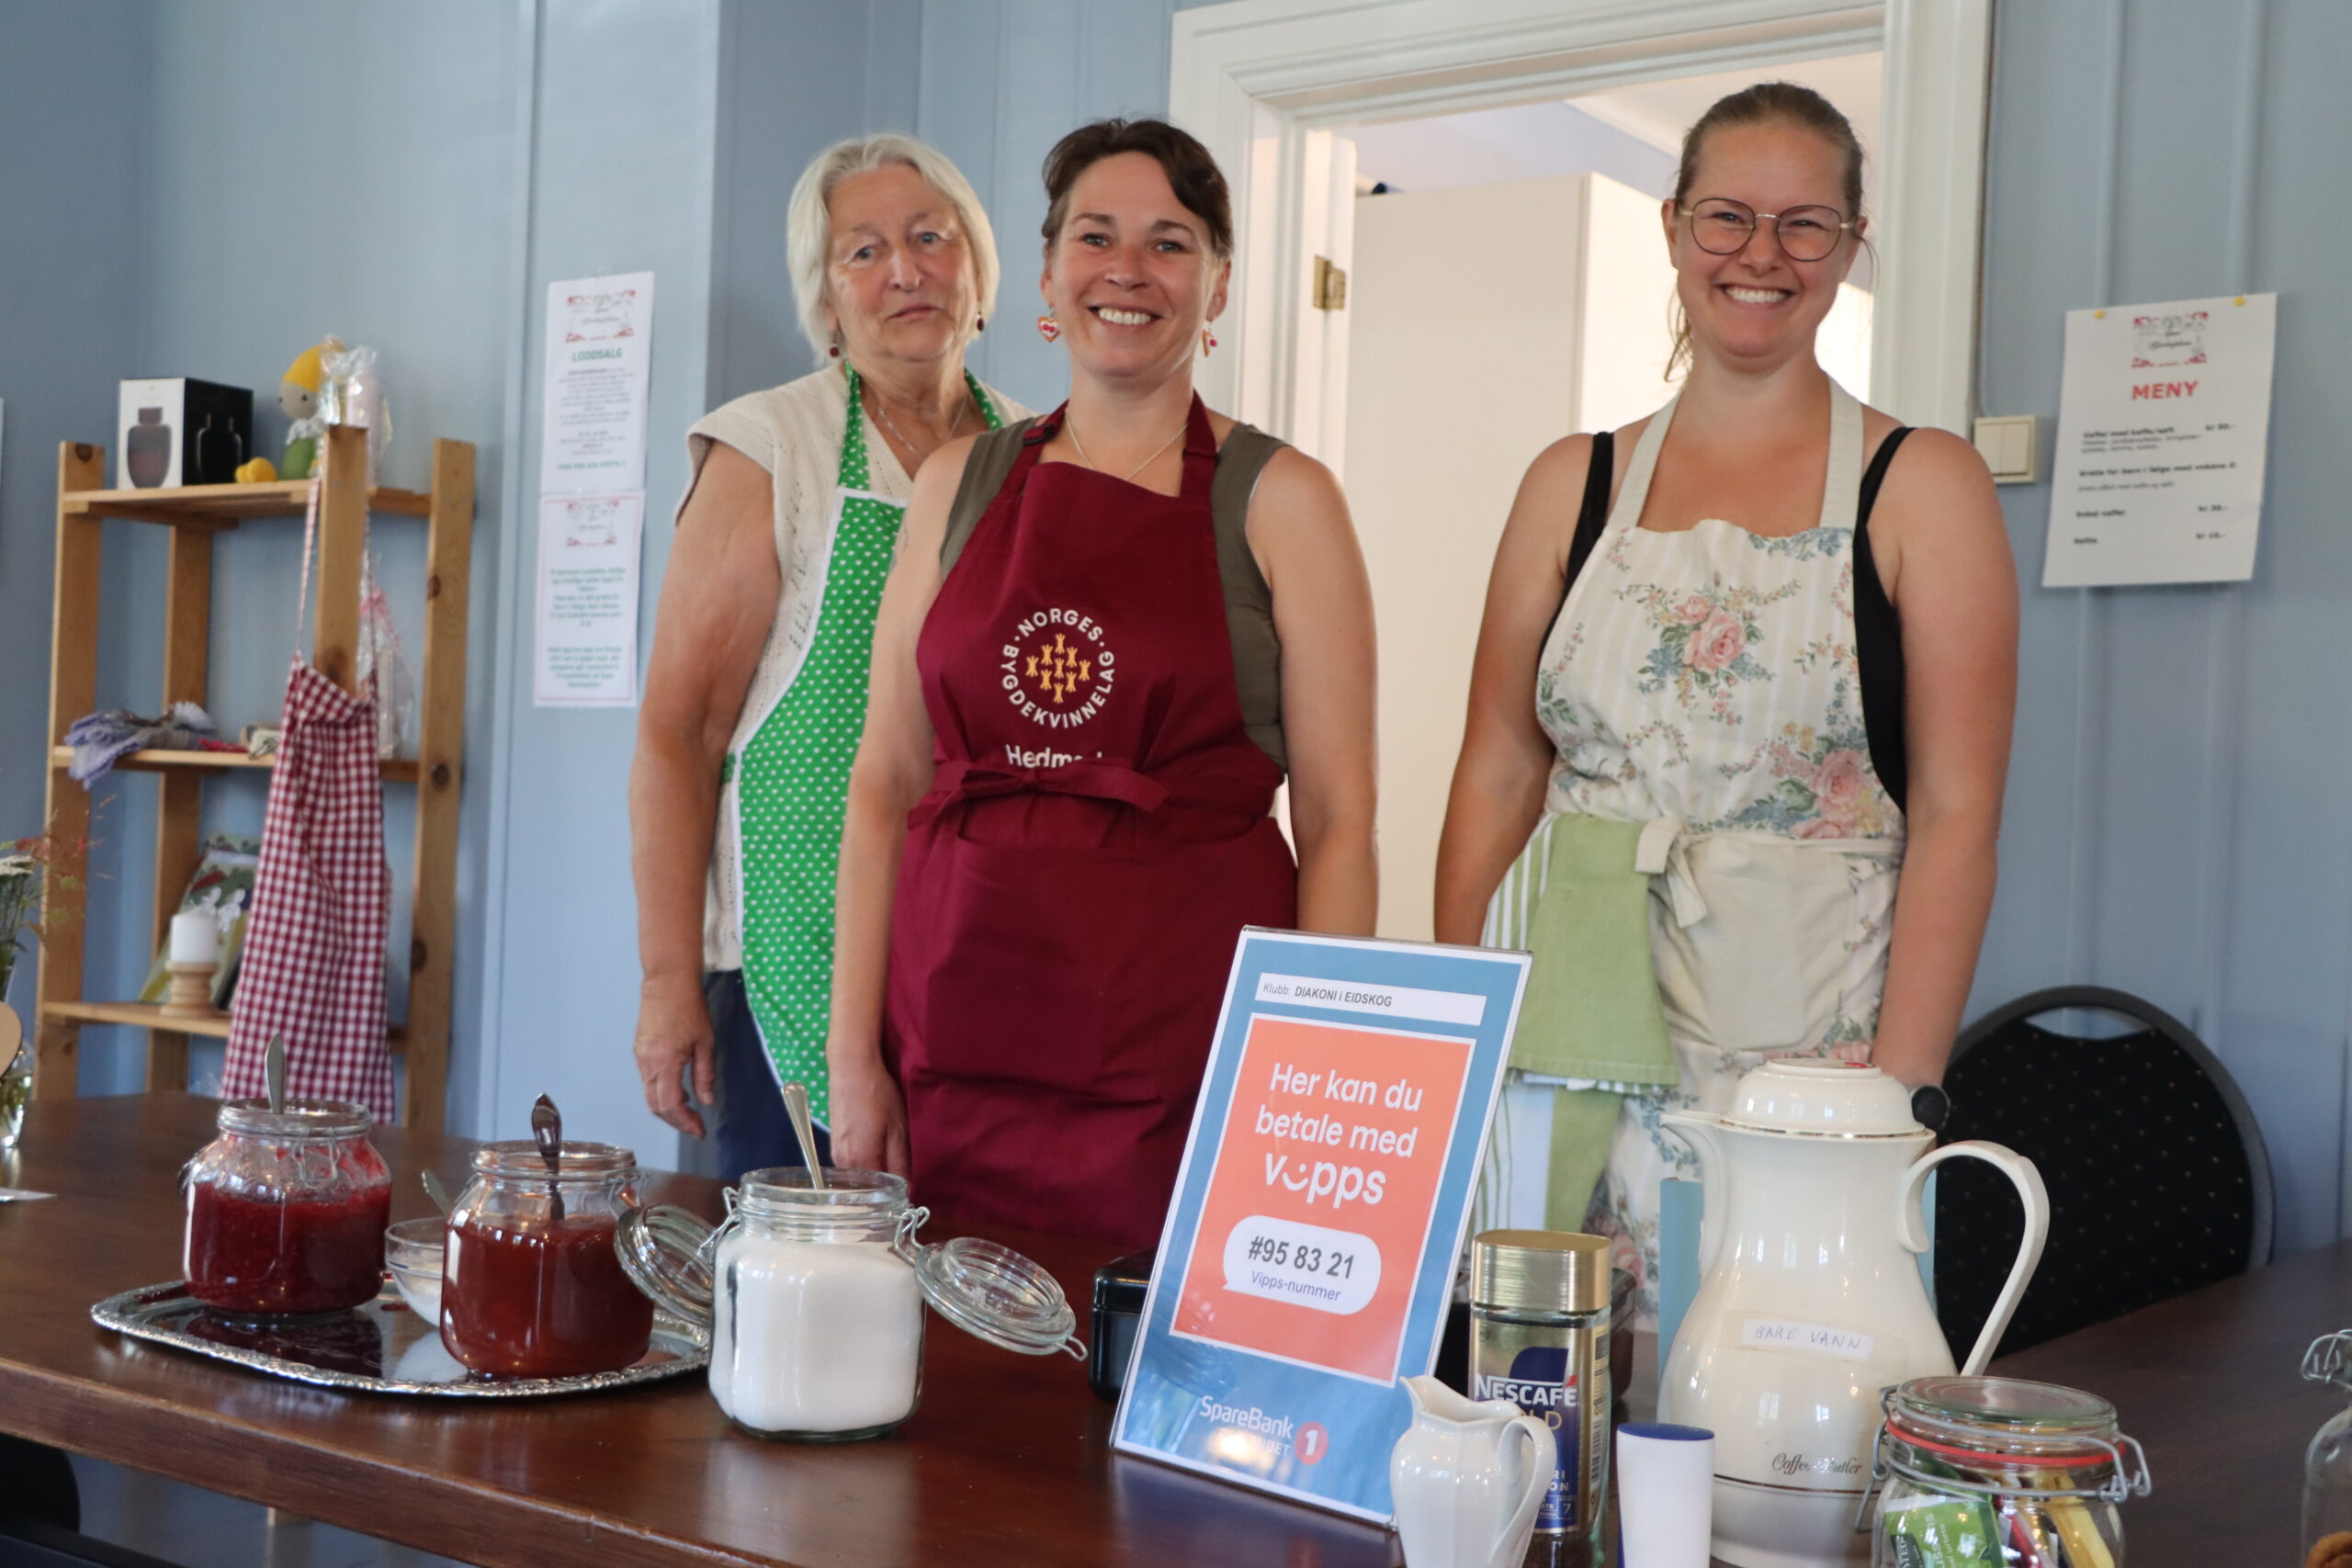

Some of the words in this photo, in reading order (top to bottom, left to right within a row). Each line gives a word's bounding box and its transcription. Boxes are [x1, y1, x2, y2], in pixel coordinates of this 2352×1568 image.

[2132, 380, 2199, 400] MENY
[1017, 607, 1103, 641] NORGES
[1001, 644, 1115, 728] BYGDEKVINNELAG
[1005, 744, 1102, 769] Hedm
[1262, 982, 1292, 996] Klubb:
[1295, 986, 1338, 1002] DIAKONI
[1344, 992, 1393, 1007] EIDSKOG
[1270, 1063, 1321, 1098] Her
[1324, 1068, 1377, 1106] kan
[1384, 1078, 1423, 1111] du
[1255, 1104, 1344, 1146] betale
[1349, 1124, 1419, 1157] med
[1248, 1235, 1289, 1266] #95
[1294, 1245, 1321, 1272] 83
[1327, 1252, 1355, 1280] 21
[1251, 1270, 1342, 1302] Vipps-nummer
[1754, 1325, 1799, 1340] BARE
[1810, 1331, 1863, 1349] VANN
[1200, 1394, 1295, 1439] SpareBank
[1771, 1452, 1812, 1475] Coffee
